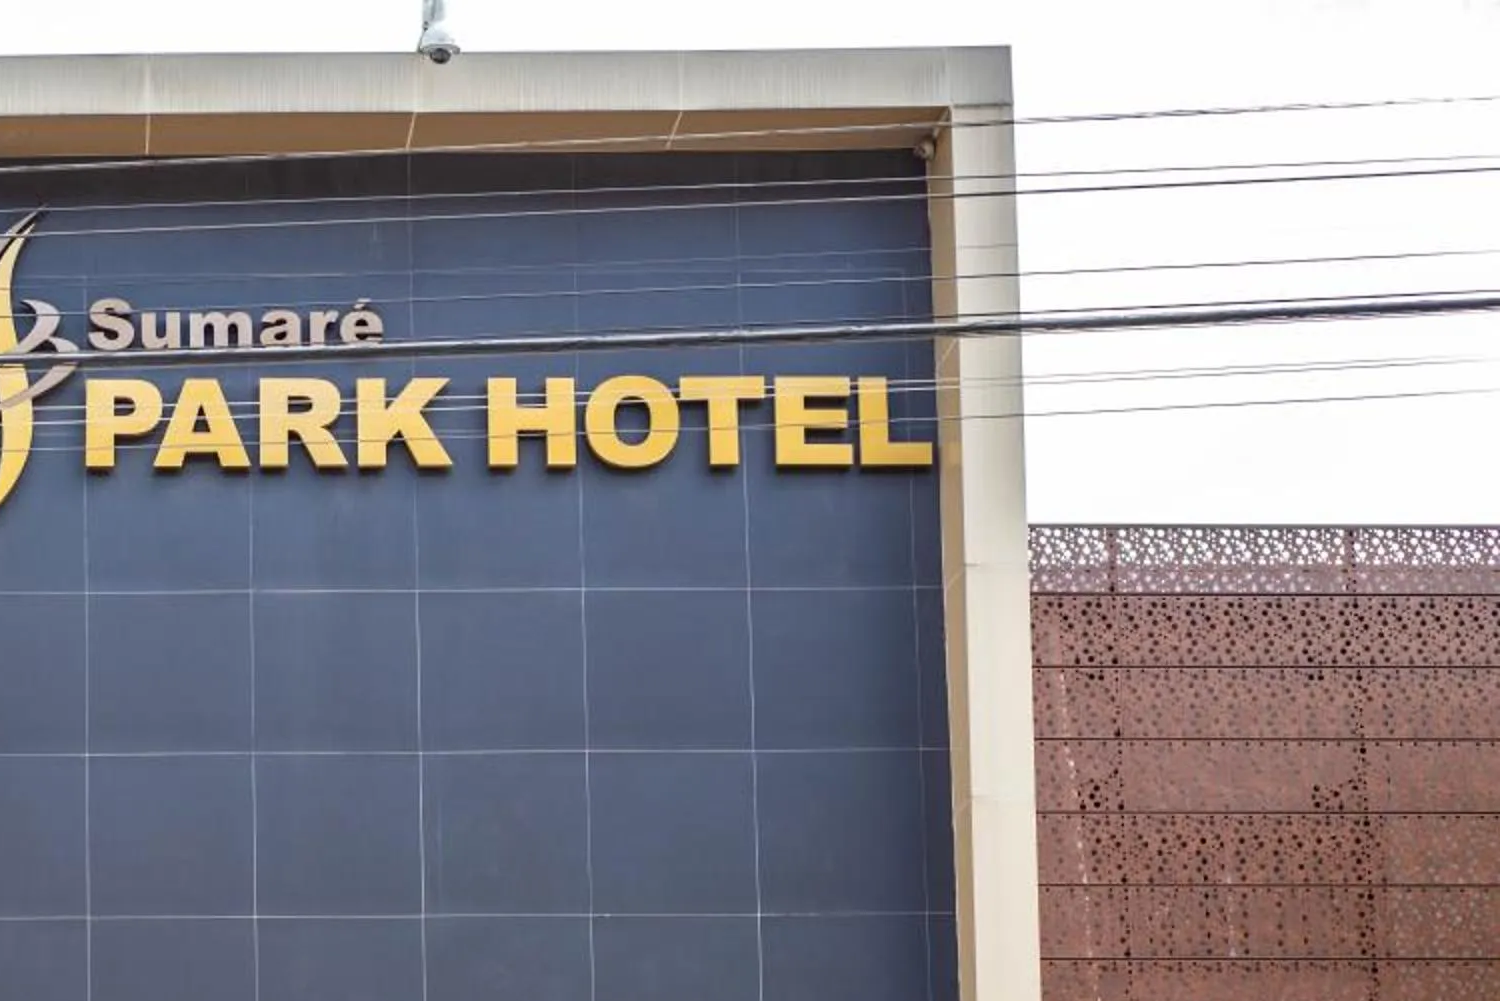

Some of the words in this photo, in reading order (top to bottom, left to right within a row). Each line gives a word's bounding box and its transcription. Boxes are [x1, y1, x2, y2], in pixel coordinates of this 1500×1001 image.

[88, 298, 384, 350] Sumaré
[85, 376, 453, 470] PARK
[486, 374, 935, 470] HOTEL
